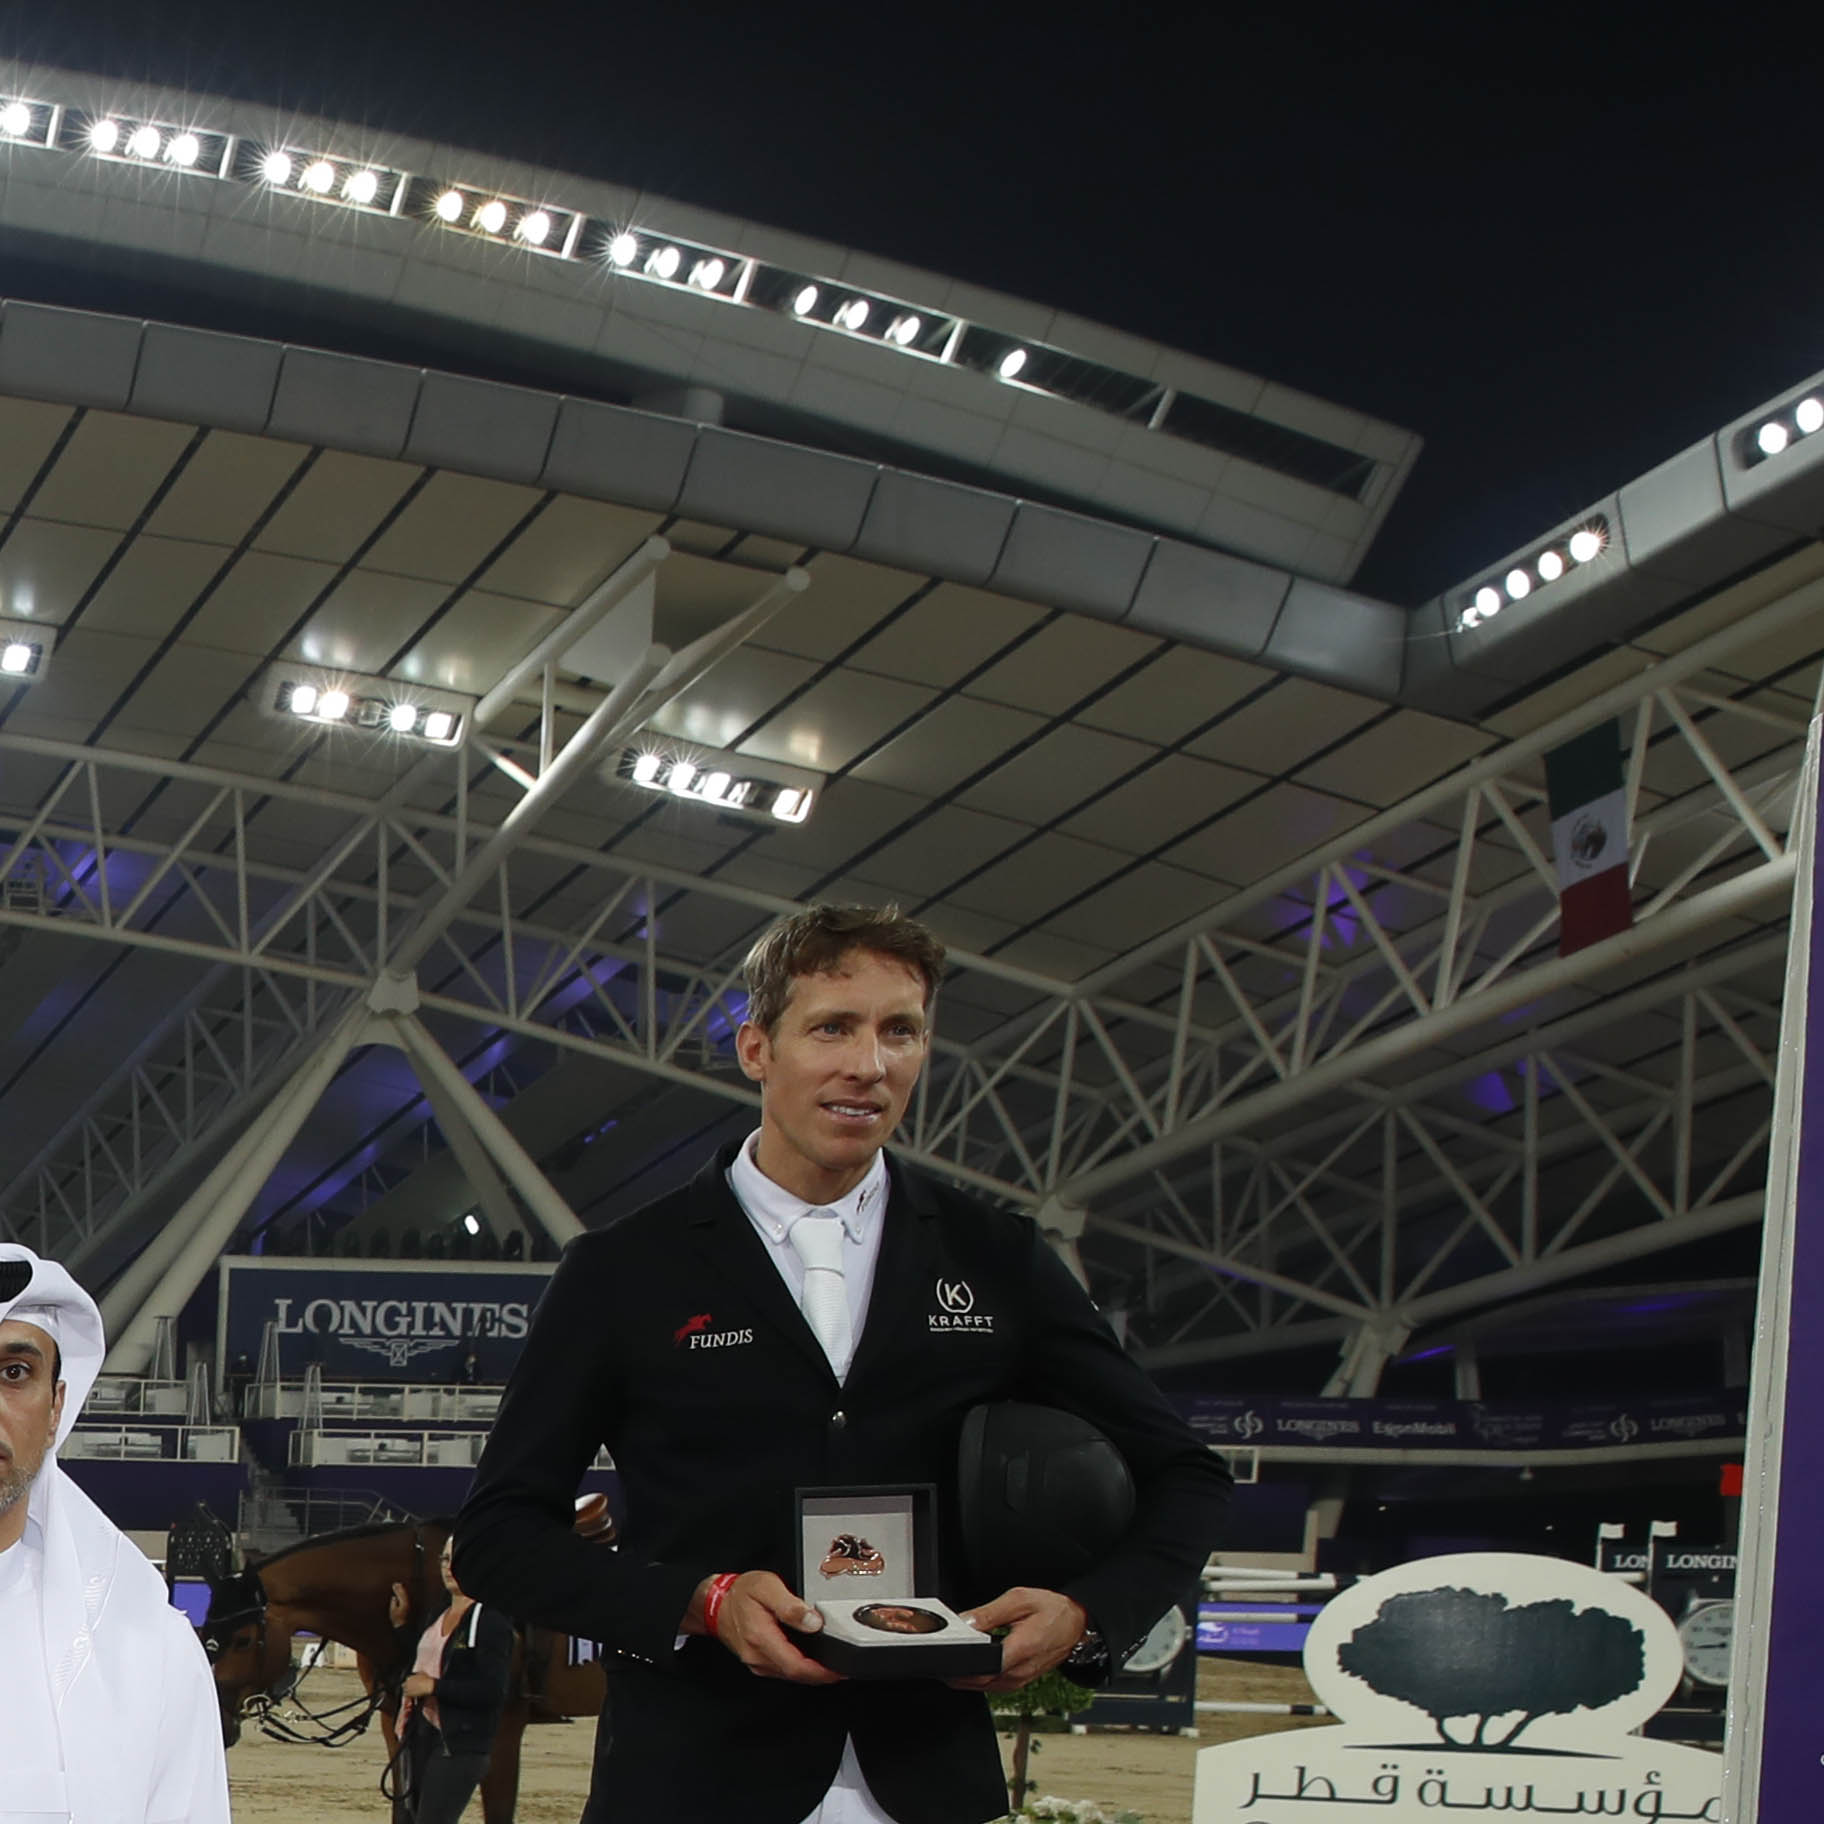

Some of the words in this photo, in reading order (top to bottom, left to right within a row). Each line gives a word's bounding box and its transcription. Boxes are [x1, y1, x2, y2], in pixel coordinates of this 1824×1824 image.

[944, 1283, 967, 1306] K
[274, 1299, 531, 1338] LONGINES
[928, 1314, 994, 1328] KRAFFT
[689, 1328, 754, 1350] FUNDIS
[1239, 1763, 1401, 1809] قطر
